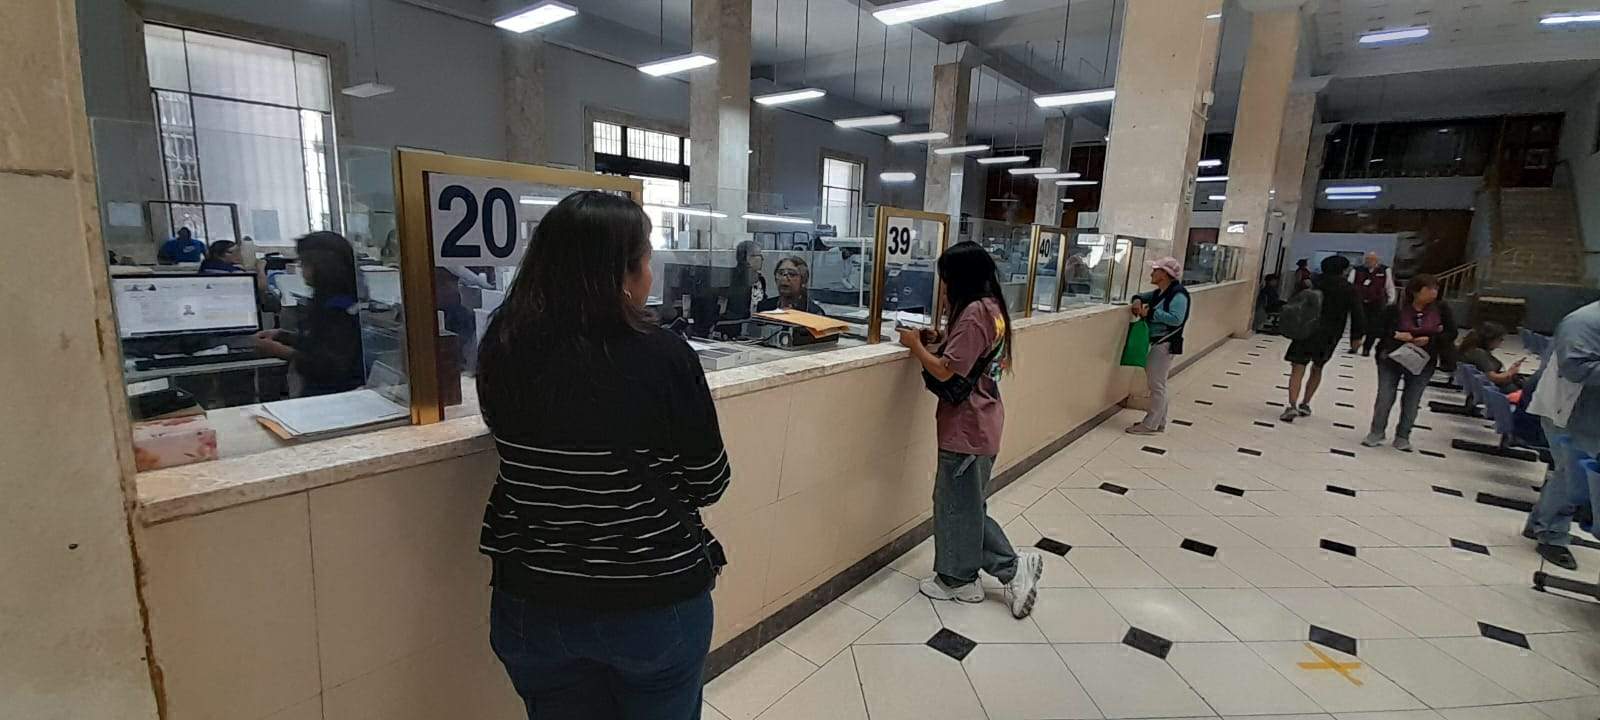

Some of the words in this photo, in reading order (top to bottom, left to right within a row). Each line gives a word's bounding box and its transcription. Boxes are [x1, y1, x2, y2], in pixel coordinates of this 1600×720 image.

[439, 186, 517, 258] 20
[888, 226, 911, 255] 39
[1039, 238, 1051, 258] 40
